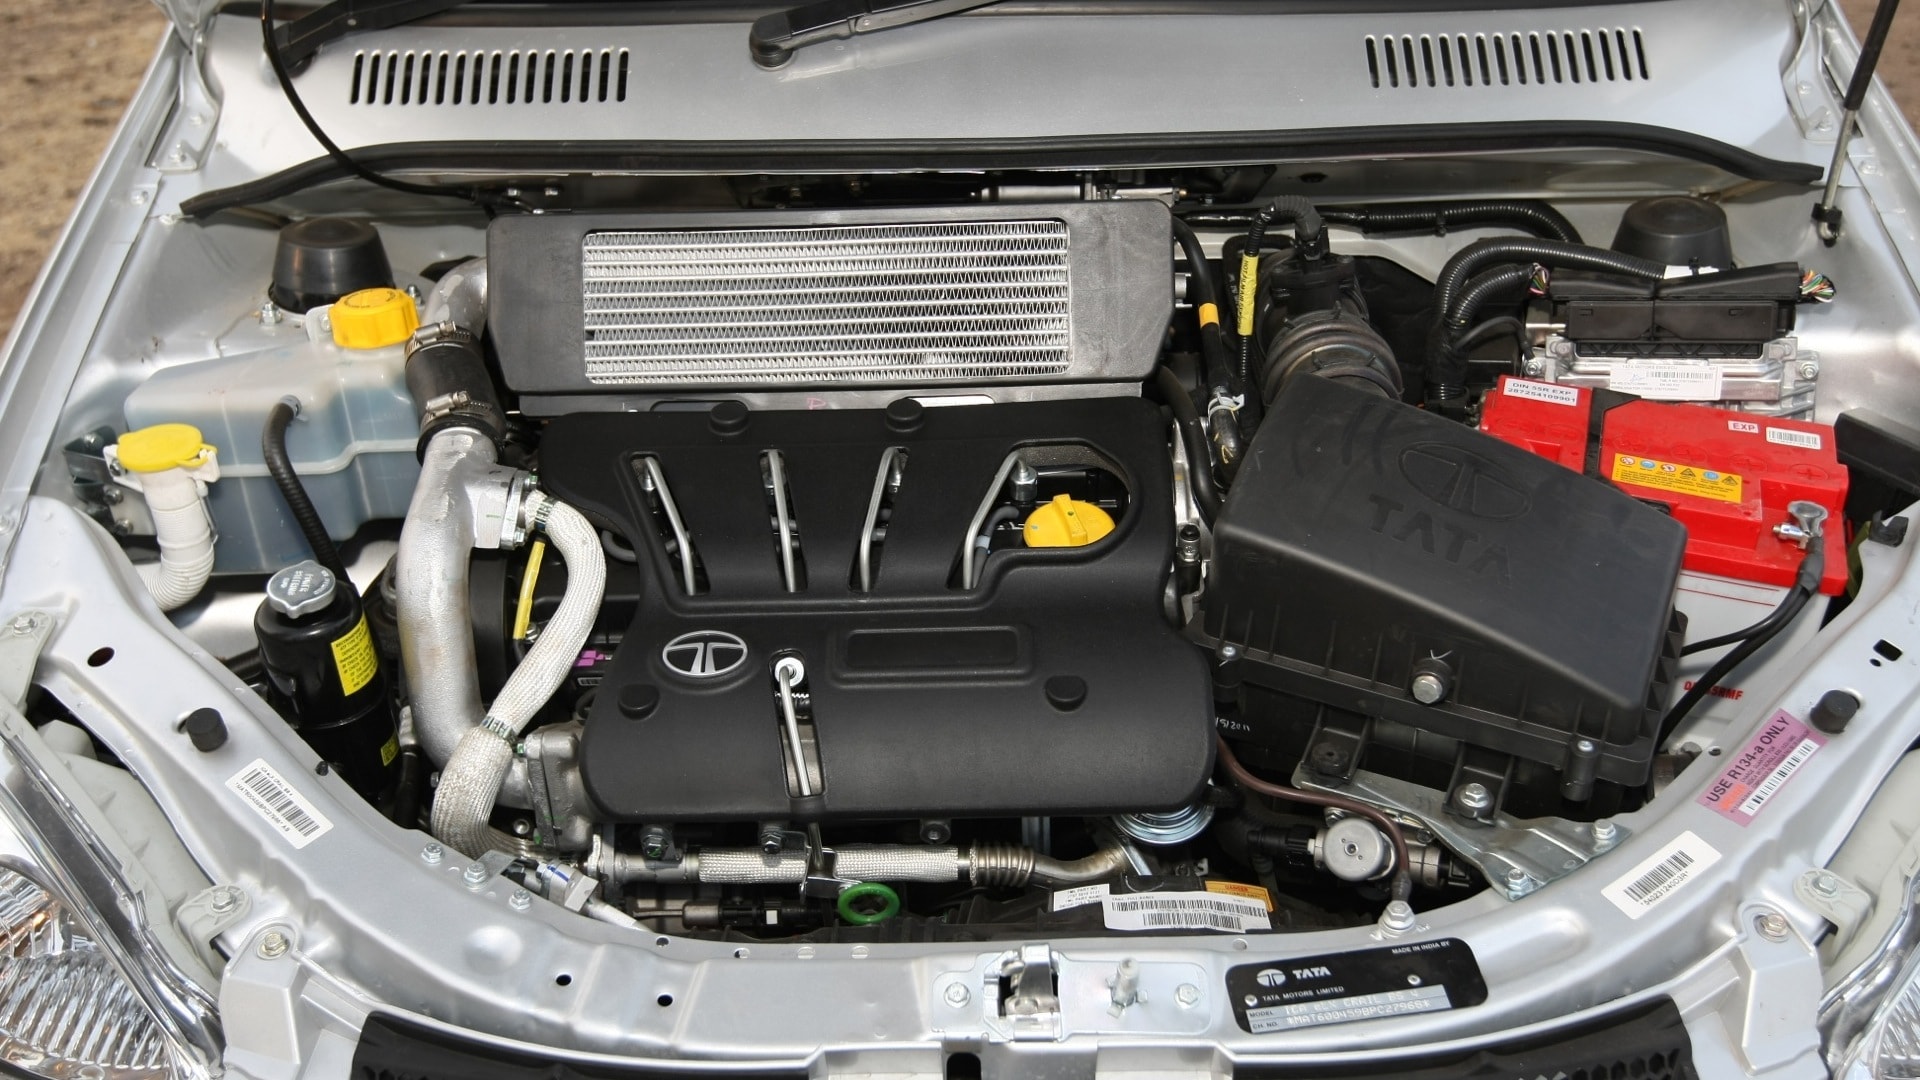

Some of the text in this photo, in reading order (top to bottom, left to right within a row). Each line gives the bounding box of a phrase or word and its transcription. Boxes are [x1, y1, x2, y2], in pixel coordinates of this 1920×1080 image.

[1733, 422, 1755, 431] EXP
[1368, 493, 1512, 583] TATA
[1706, 779, 1732, 802] USE
[1727, 745, 1763, 779] R134-a
[1760, 716, 1790, 744] ONLY
[1421, 942, 1440, 950] INDIA
[1292, 966, 1331, 979] TATA
[1283, 990, 1314, 999] MOTORS
[1316, 986, 1344, 995] LIMITED
